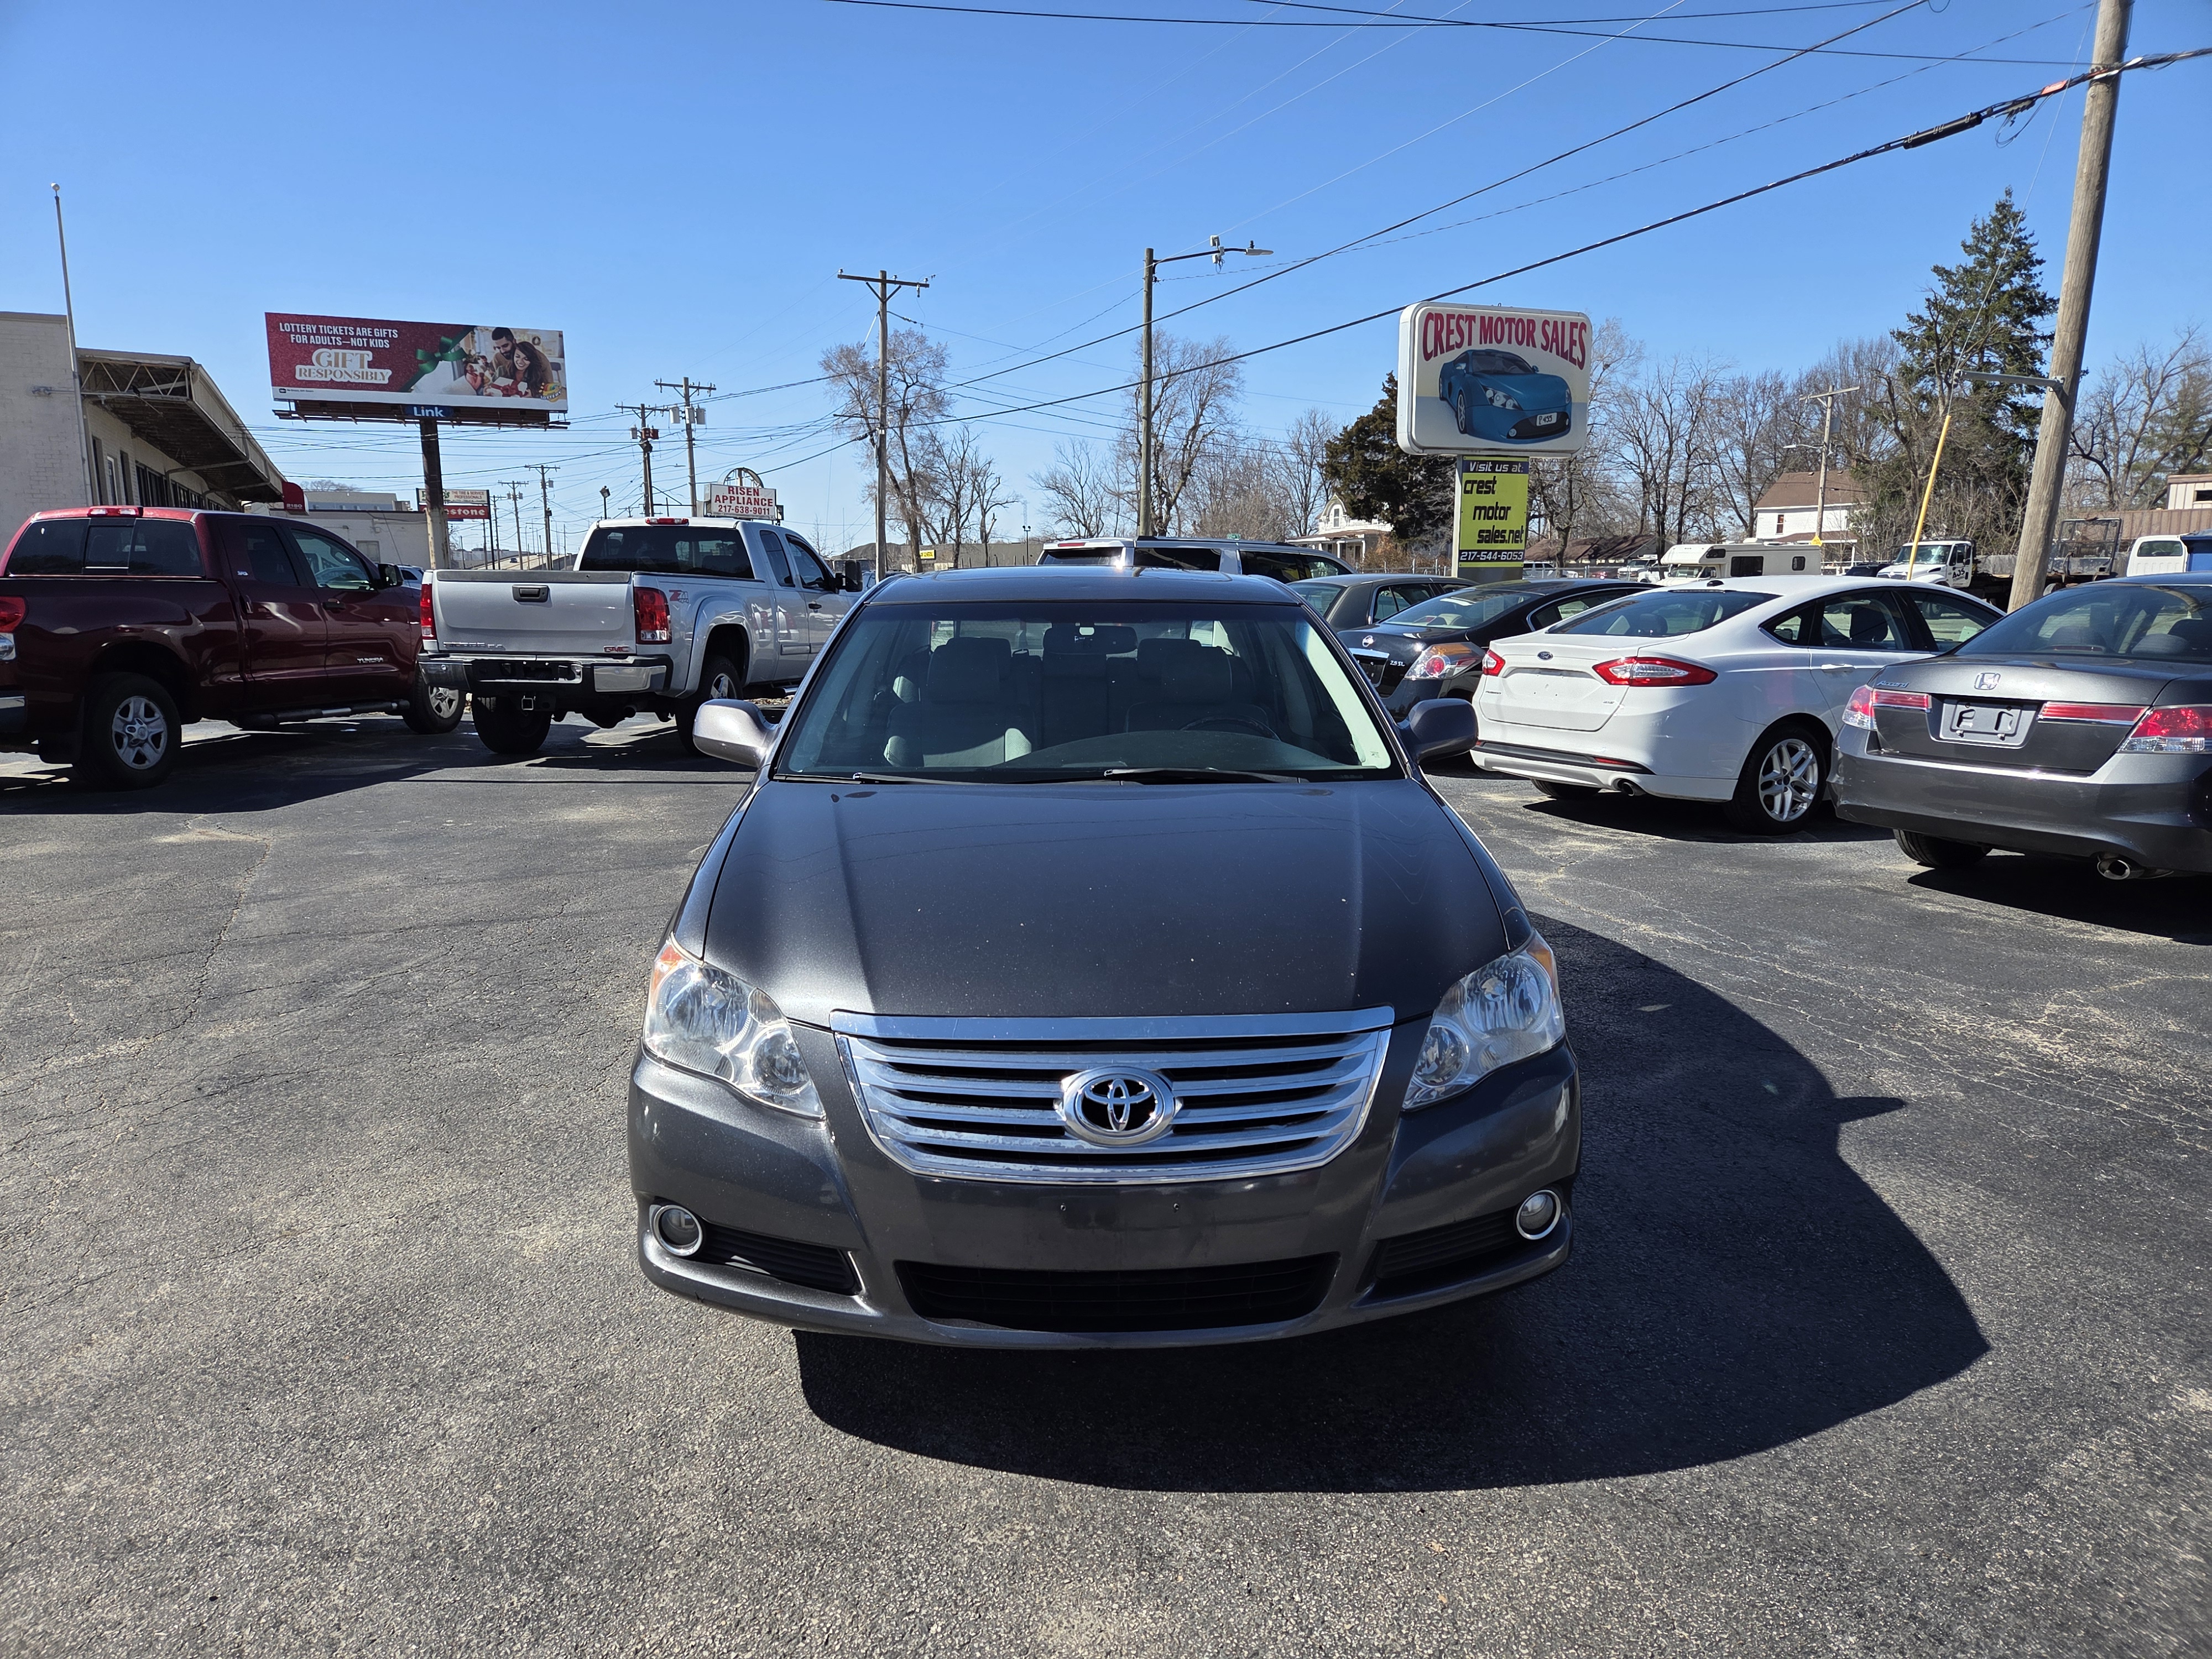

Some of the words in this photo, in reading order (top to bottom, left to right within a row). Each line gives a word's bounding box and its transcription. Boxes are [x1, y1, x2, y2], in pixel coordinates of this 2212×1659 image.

[279, 322, 317, 334] LOTTERY
[318, 324, 354, 336] TICKETS
[356, 326, 374, 337] ARE
[375, 327, 398, 338] GIFTS
[290, 334, 307, 344] FOR
[369, 337, 390, 348] KIDS
[1423, 312, 1476, 361] CREST
[1479, 316, 1536, 348] MOTOR
[1541, 319, 1587, 370] SALES
[315, 350, 370, 369] GIFT
[298, 367, 388, 382] RESPONSIBLY
[413, 405, 445, 418] Link
[1470, 462, 1492, 472] Visit
[1495, 464, 1509, 472] us
[728, 486, 759, 497] RISEN
[1463, 476, 1497, 494] crest
[714, 495, 773, 507] APPLIANCE
[718, 505, 770, 515] 217-638-9011
[1473, 502, 1511, 520] motor
[1477, 525, 1524, 544] sales.net
[1460, 551, 1524, 561] 217-544-6053
[1952, 568, 1965, 578] AJS
